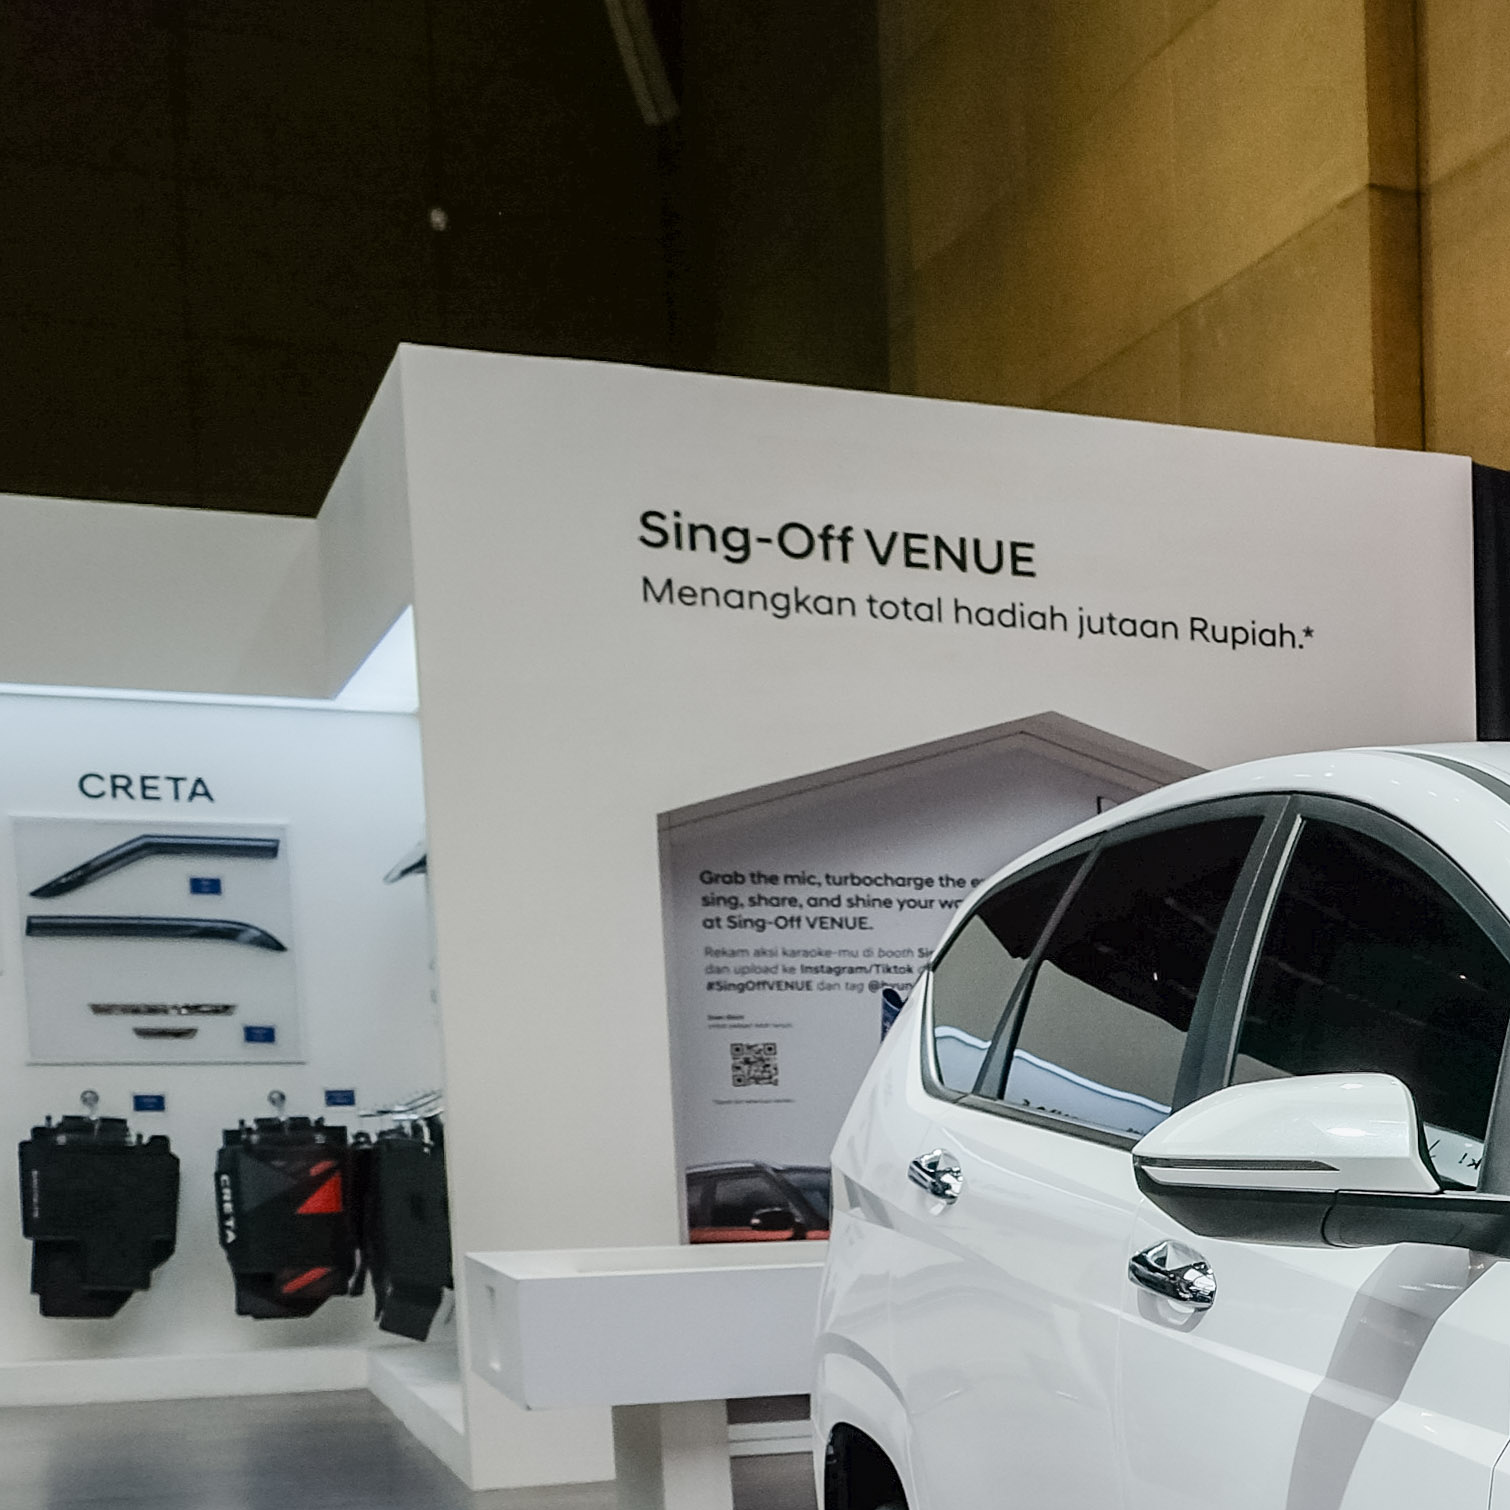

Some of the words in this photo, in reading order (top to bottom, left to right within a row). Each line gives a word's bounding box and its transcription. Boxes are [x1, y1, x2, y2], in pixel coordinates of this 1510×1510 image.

[638, 510, 854, 564] Sing-Off
[863, 528, 1037, 578] VENUE
[641, 575, 857, 618] Menangkan
[866, 593, 943, 624] total
[954, 598, 1068, 633] hadiah
[1076, 606, 1179, 641] jutaan
[78, 773, 215, 803] CRETA
[700, 870, 746, 885] Grab
[749, 871, 779, 885] the
[783, 871, 822, 887] mic,
[824, 873, 935, 890] turbocharge
[938, 874, 967, 888] the
[701, 892, 745, 910] sing,
[749, 894, 803, 909] share,
[806, 895, 841, 908] and
[846, 894, 893, 908] shine
[896, 899, 934, 911] your
[702, 916, 722, 929] at
[726, 914, 802, 932] Sing-Off
[806, 916, 874, 930] VENUE.
[704, 946, 750, 957] Rekam
[753, 946, 778, 957] aksi
[781, 947, 858, 958] karaoke-mu
[878, 947, 914, 957] booth
[705, 964, 729, 974] dan
[733, 964, 778, 976] upload
[782, 964, 797, 974] ke
[800, 964, 913, 976] Instagram/Tiktok
[706, 980, 813, 993] #SingOffVENUE
[817, 981, 841, 991] dan
[220, 1174, 237, 1244] CRETA
